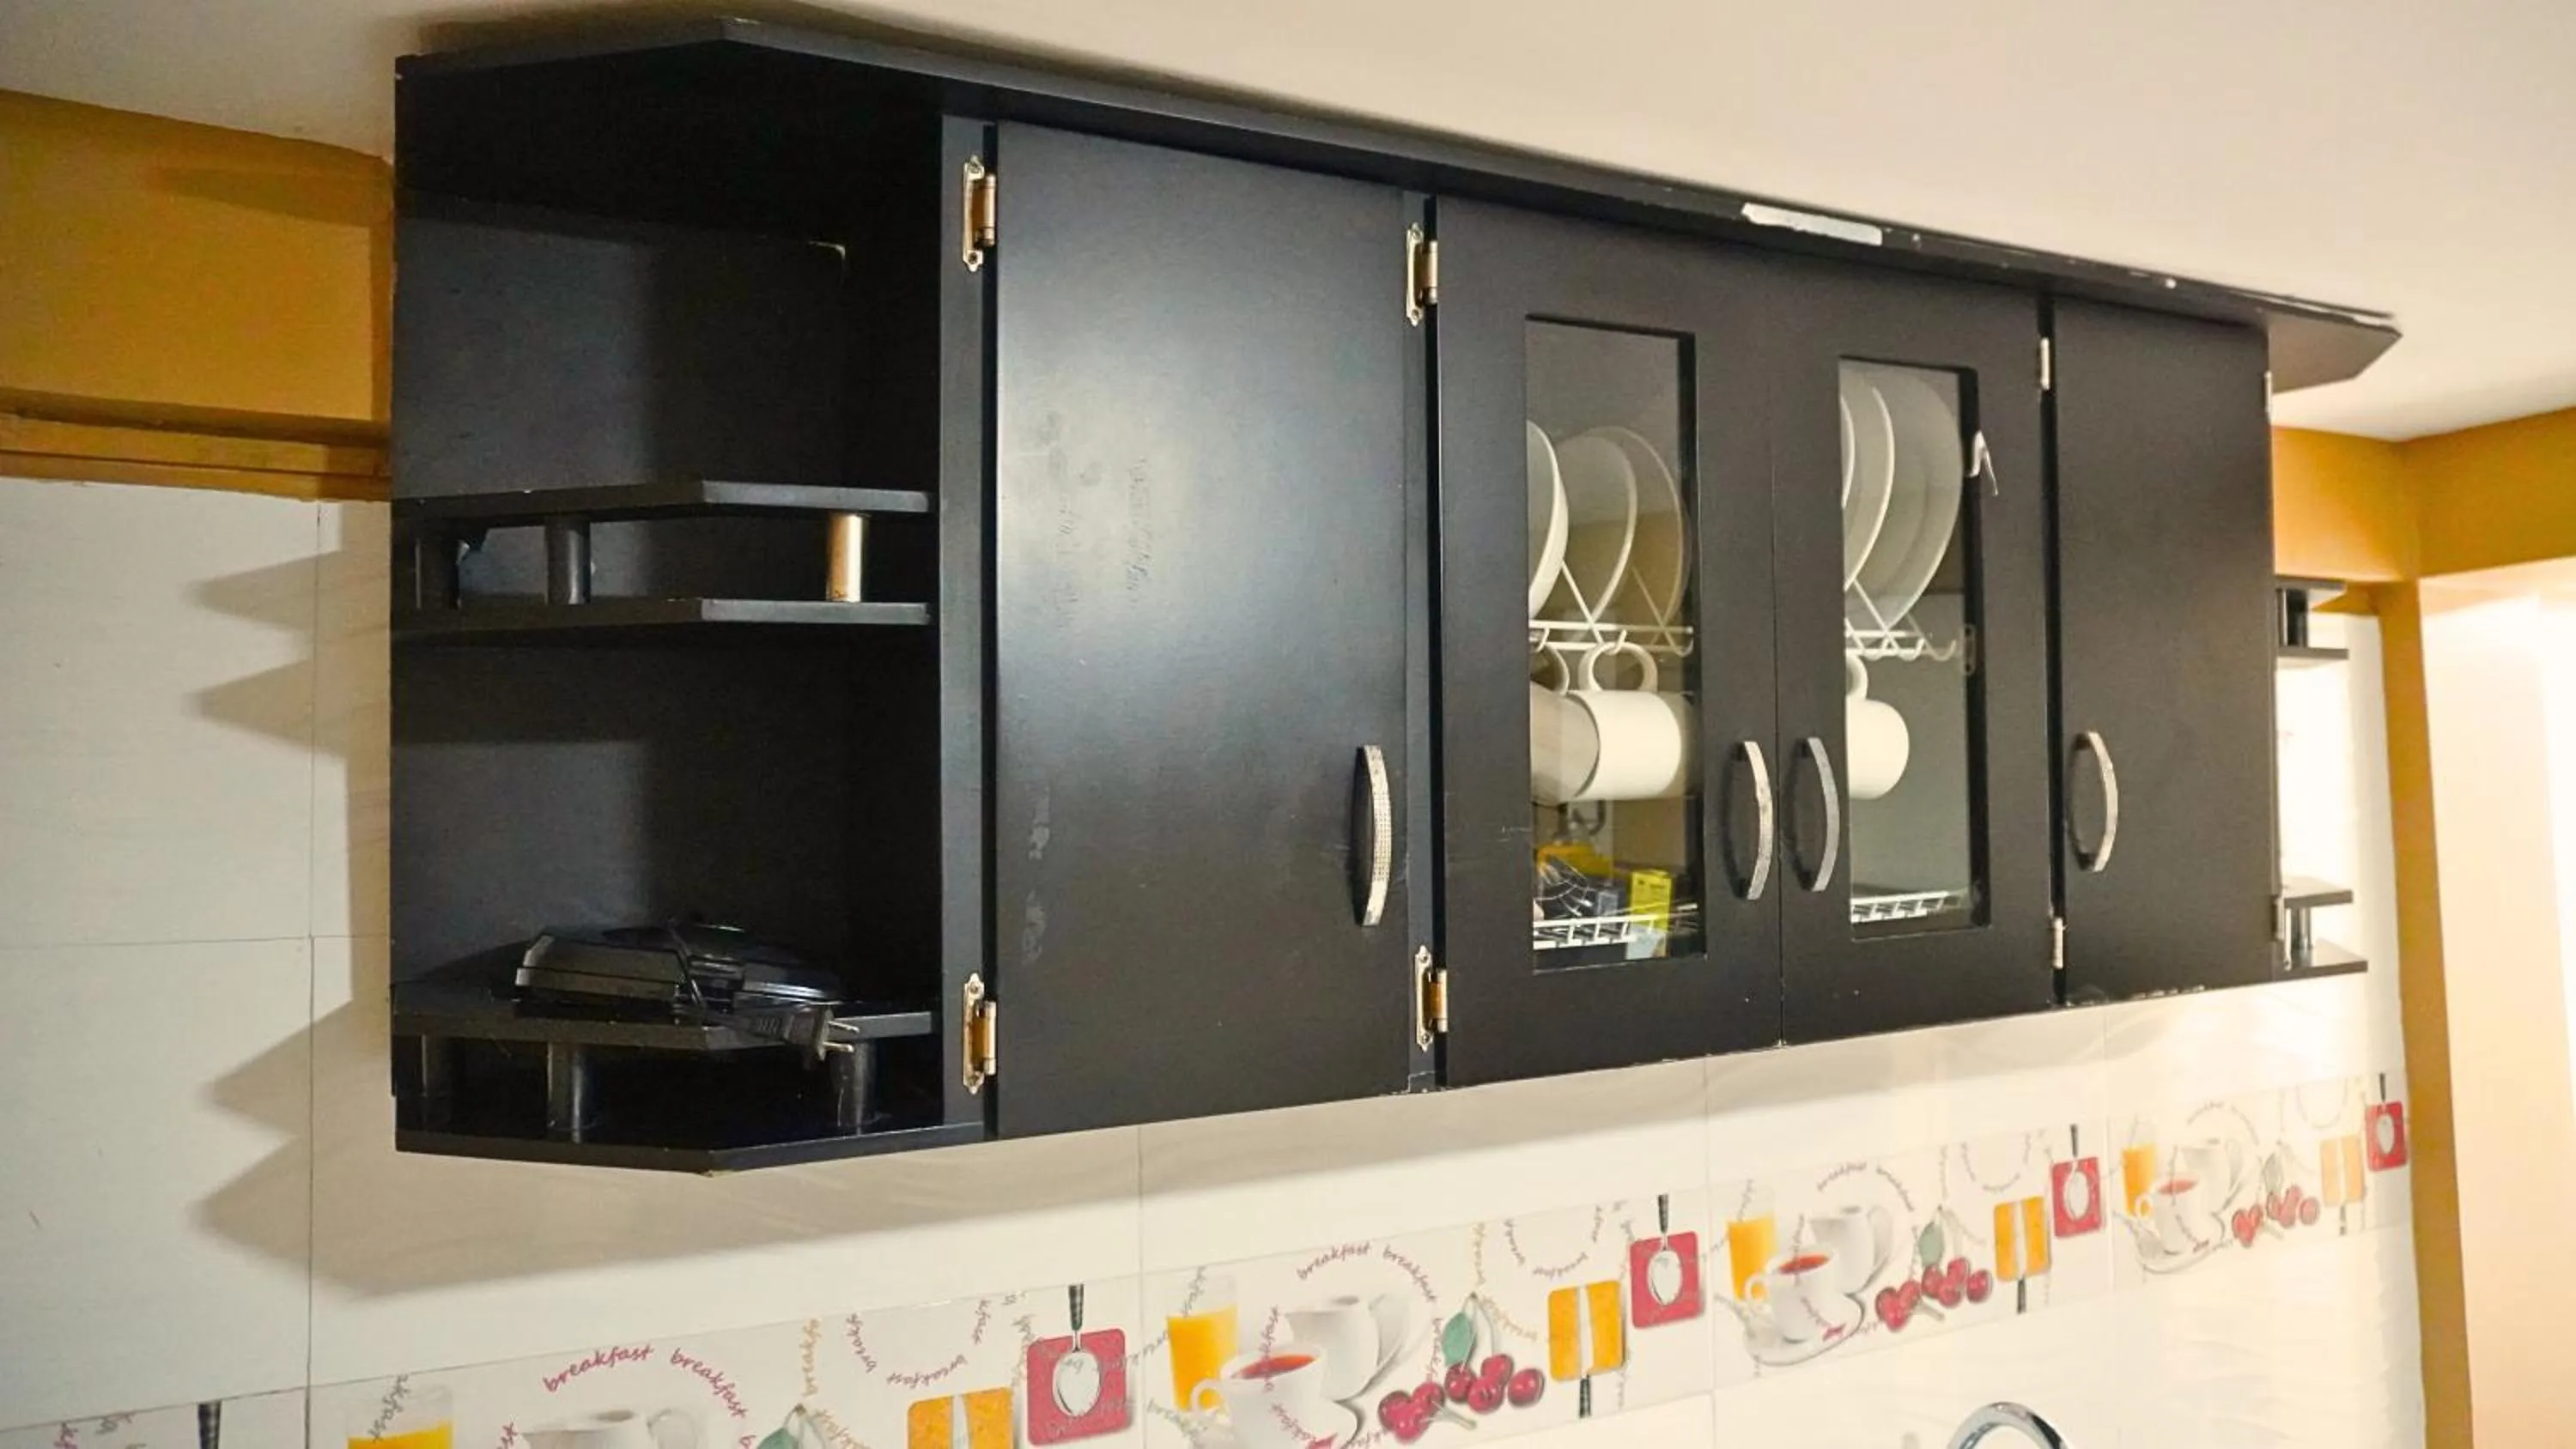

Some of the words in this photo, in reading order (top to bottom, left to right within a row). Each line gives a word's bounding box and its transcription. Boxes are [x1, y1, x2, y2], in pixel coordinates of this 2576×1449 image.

[1297, 1242, 1371, 1281] breakfast
[1382, 1244, 1437, 1302] breakfast
[543, 1343, 653, 1392] breakfast
[671, 1347, 748, 1418] breakfast
[886, 1354, 968, 1389] breakfast
